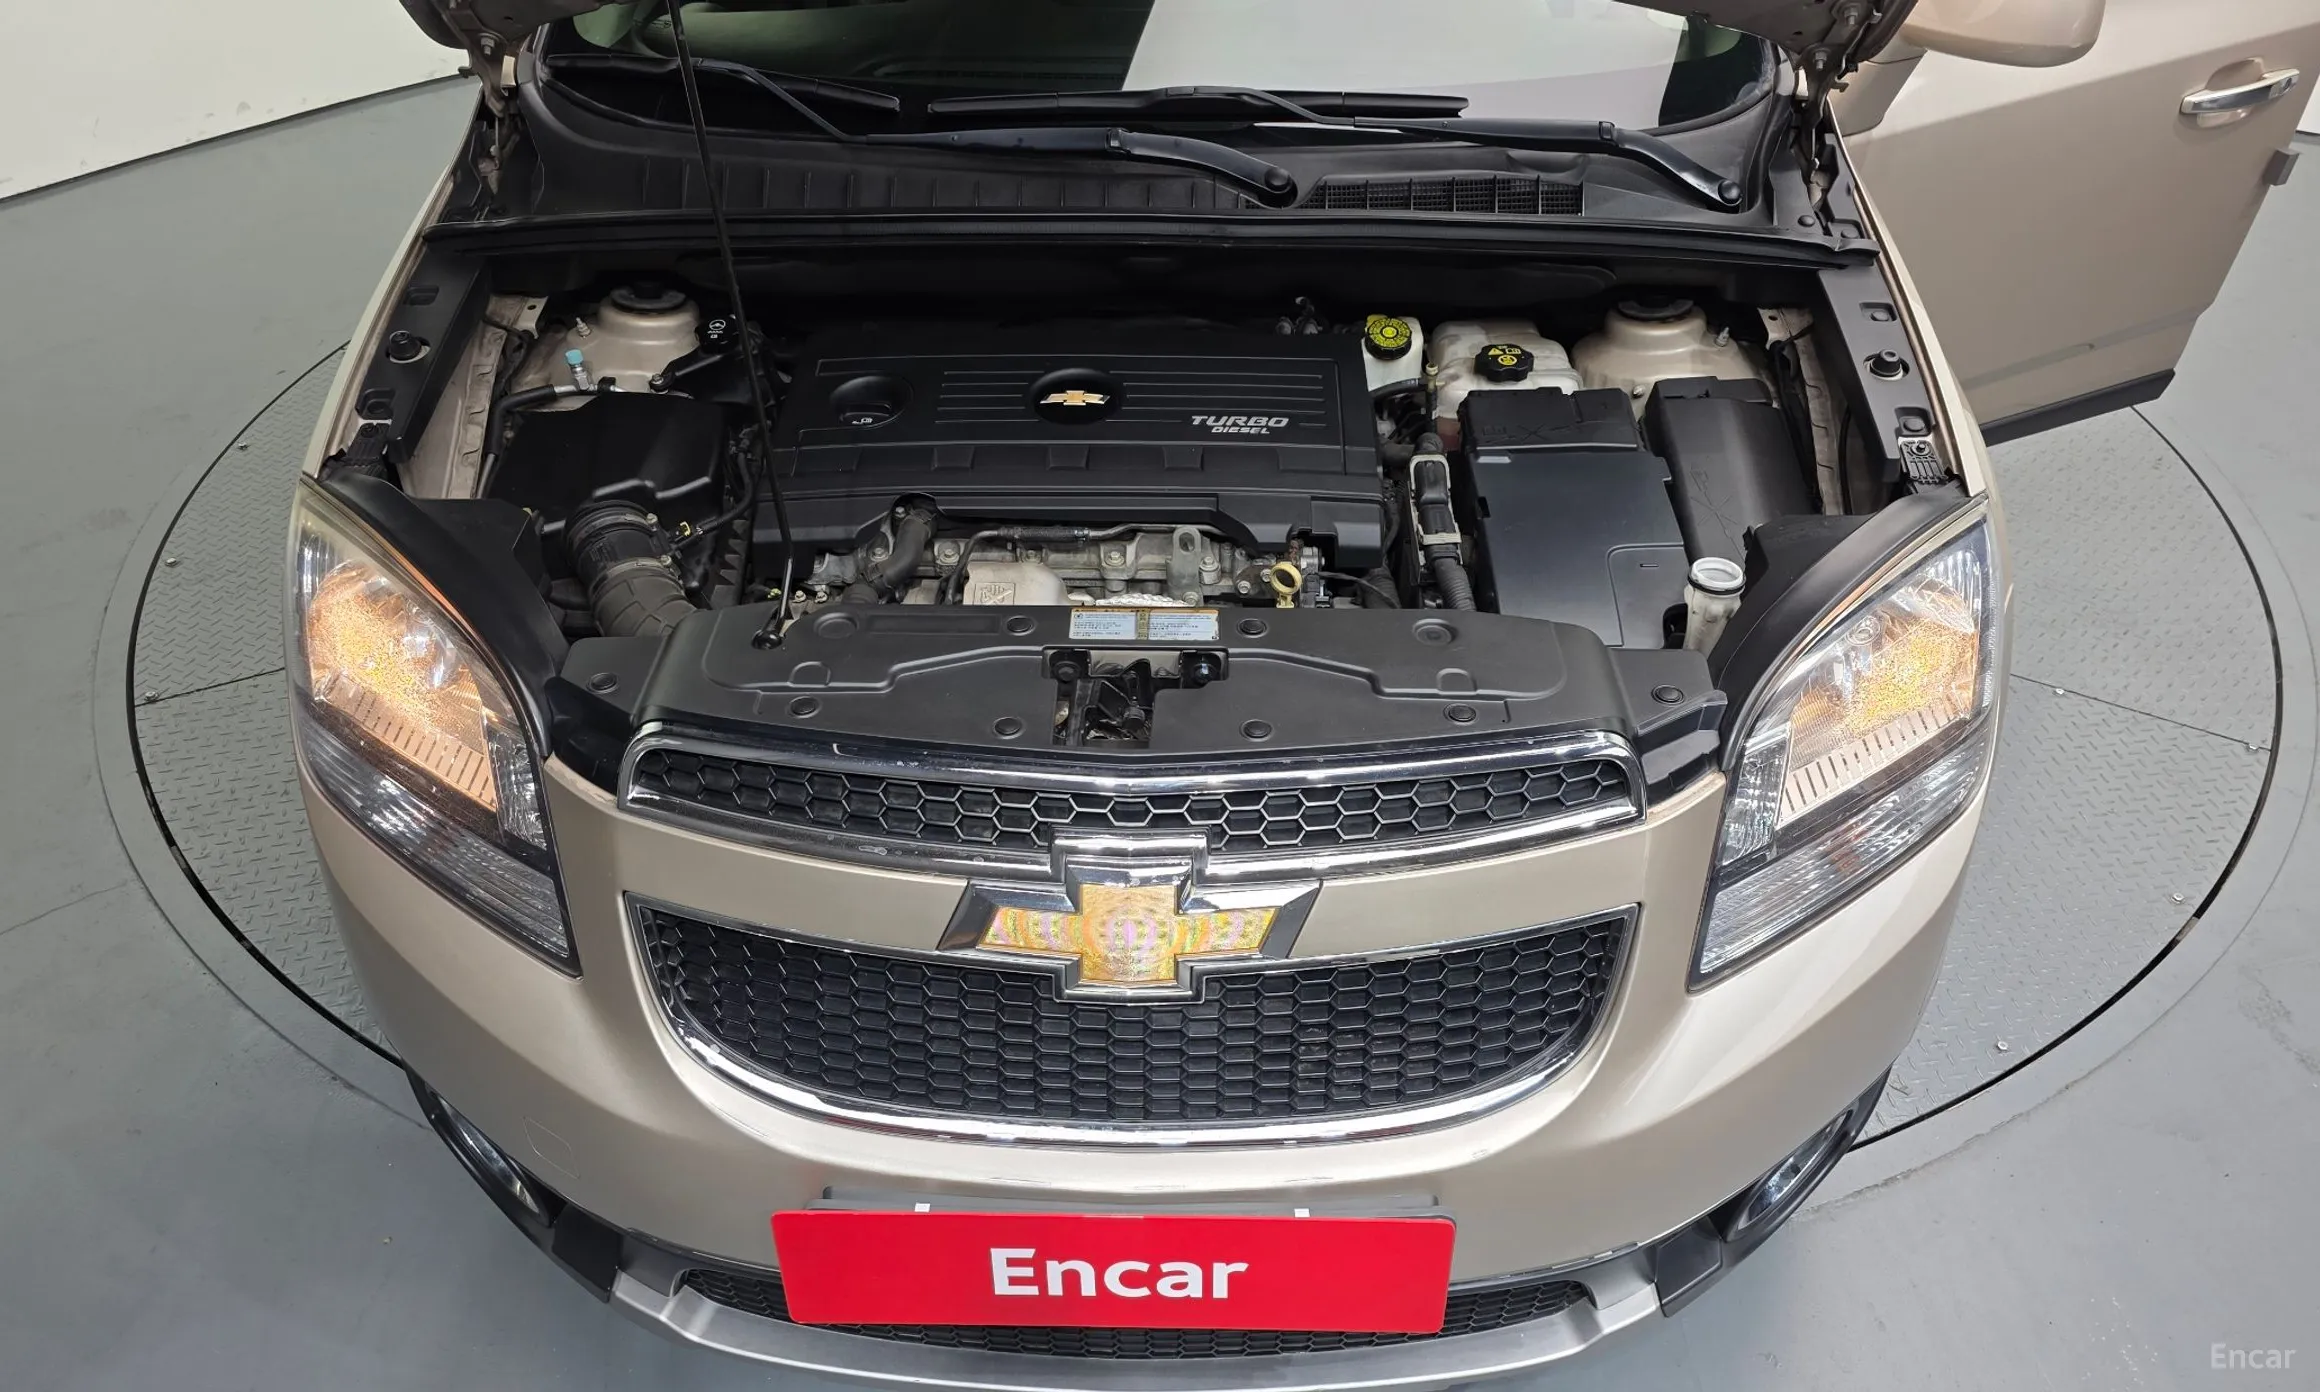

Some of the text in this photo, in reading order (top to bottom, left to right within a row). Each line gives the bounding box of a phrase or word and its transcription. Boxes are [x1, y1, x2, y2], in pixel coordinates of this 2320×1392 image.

[1191, 415, 1289, 428] TURBO
[1211, 426, 1270, 434] DIESEL
[989, 1247, 1249, 1299] Encar
